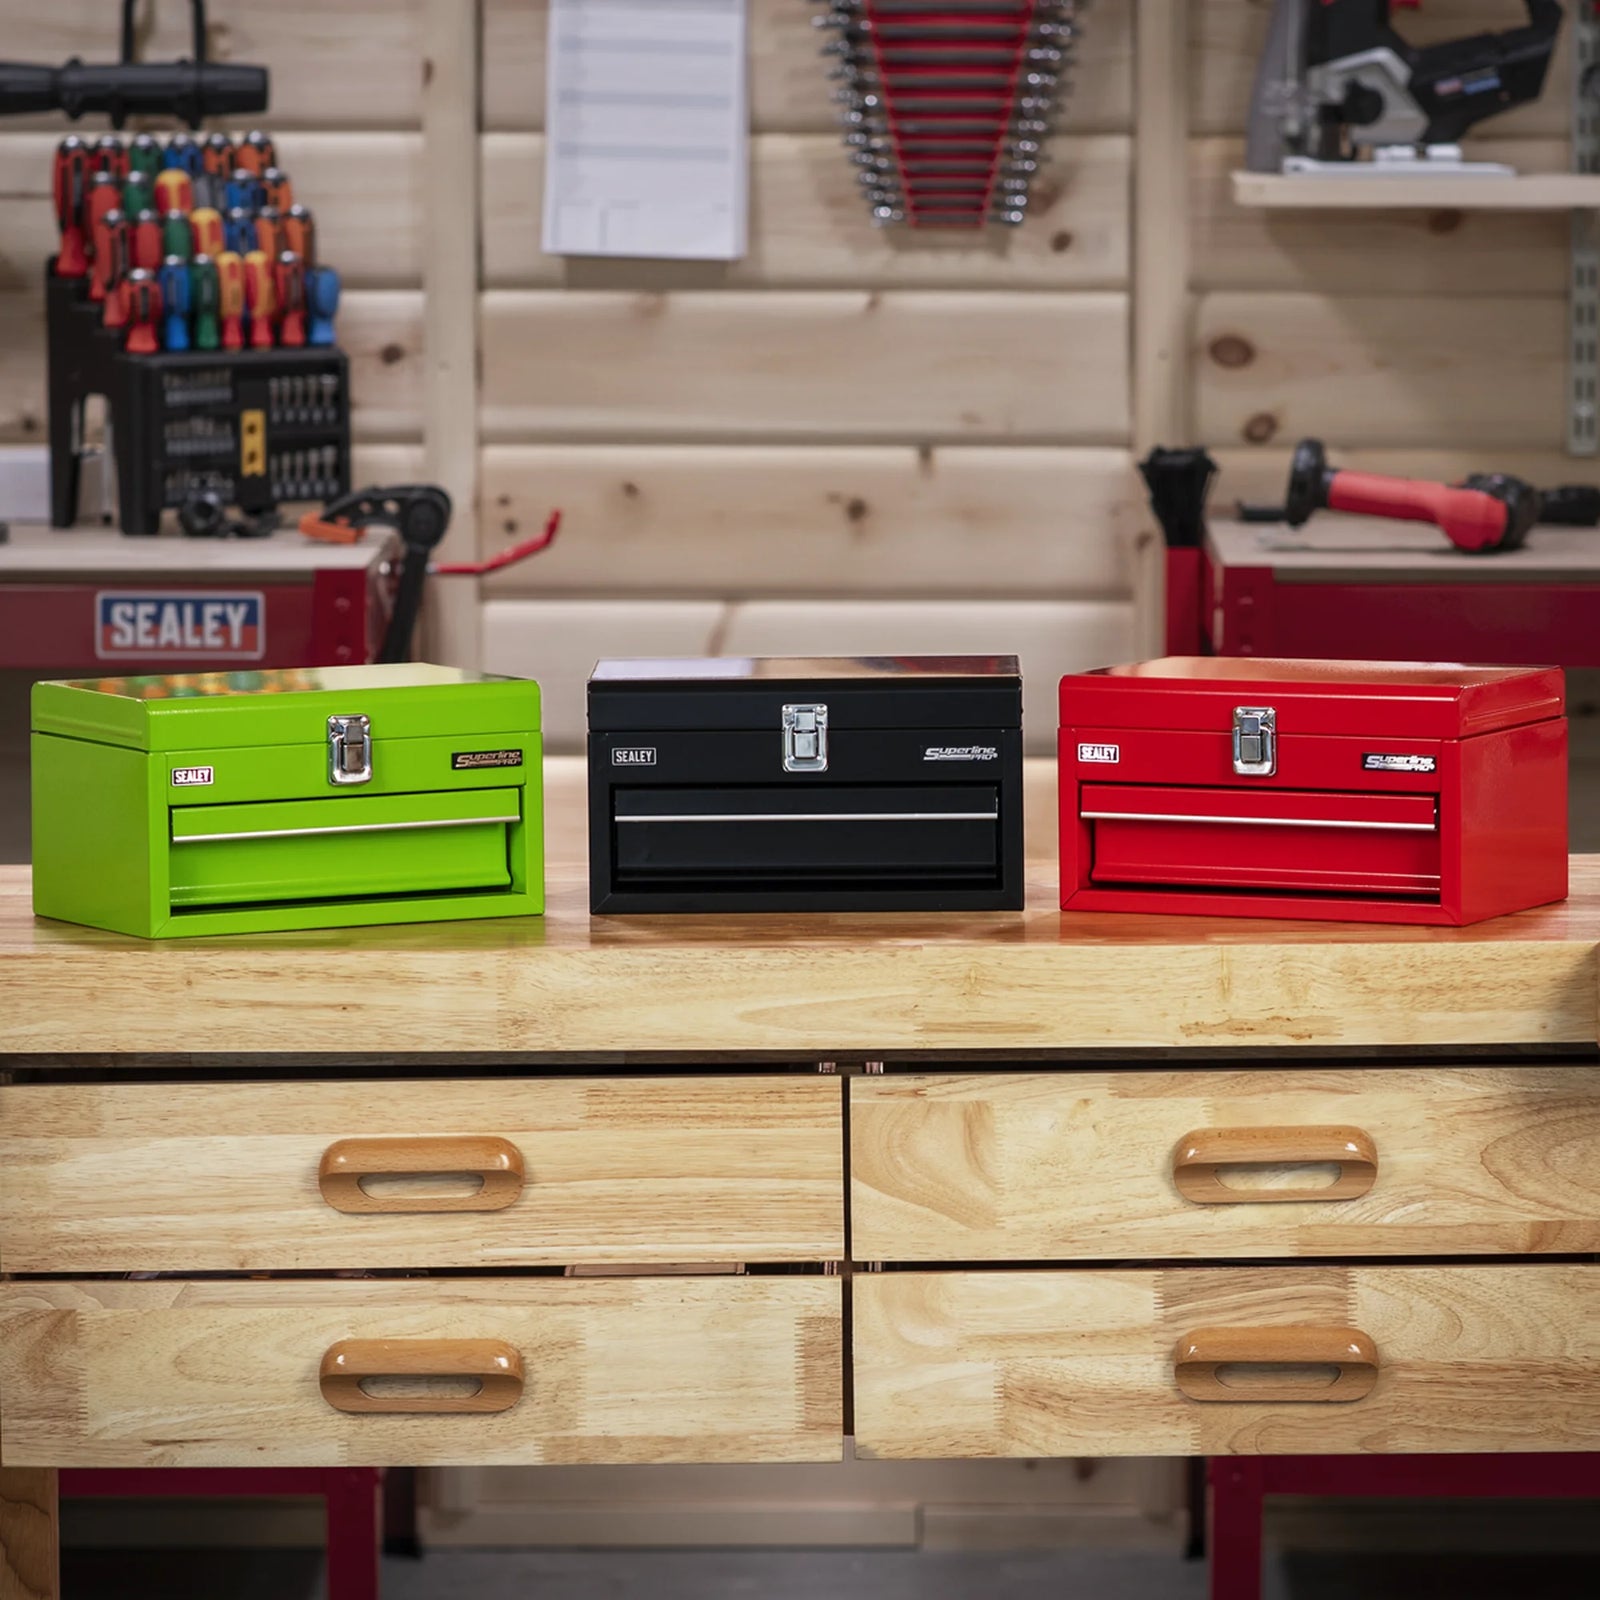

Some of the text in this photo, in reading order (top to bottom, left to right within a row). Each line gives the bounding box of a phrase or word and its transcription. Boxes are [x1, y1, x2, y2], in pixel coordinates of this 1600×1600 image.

[111, 602, 249, 648] SEALEY
[455, 751, 520, 767] Superline
[616, 750, 653, 763] SEALEY
[923, 746, 996, 761] Superline
[1081, 746, 1116, 760] SEALEY
[1364, 755, 1433, 768] Superline
[175, 769, 210, 783] SEALEY
